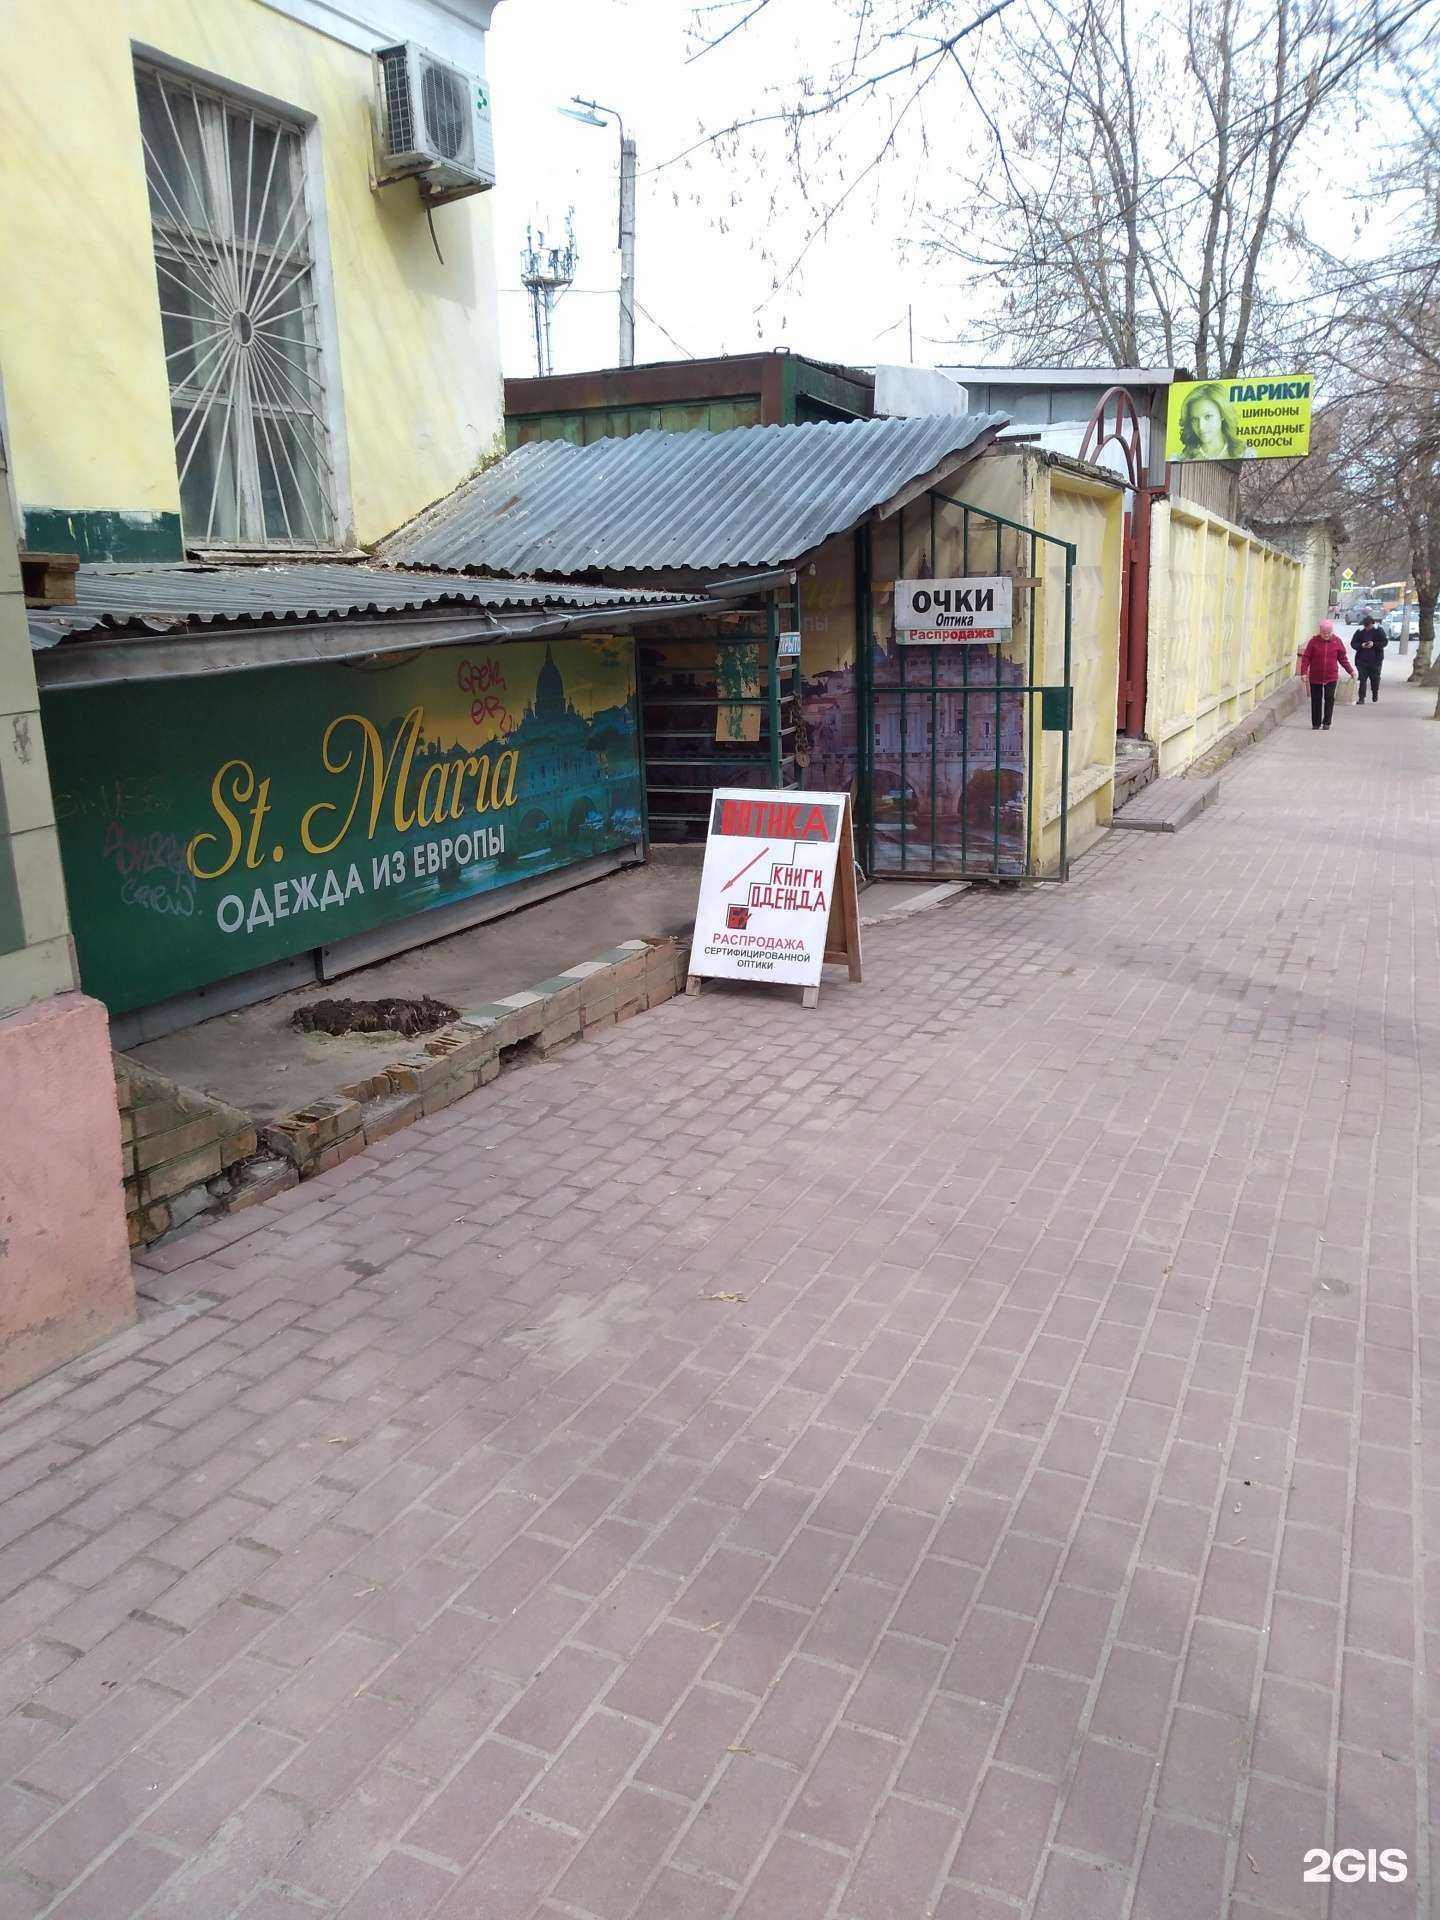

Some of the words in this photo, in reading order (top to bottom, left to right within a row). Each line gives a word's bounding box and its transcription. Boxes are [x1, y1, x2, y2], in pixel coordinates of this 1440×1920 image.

[1229, 382, 1310, 402] ПАРИКИ
[1242, 407, 1299, 418] ШИНЬОНЫ
[1236, 424, 1305, 436] НАКЛАДНЫЕ
[1246, 437, 1293, 447] ВОЛОСЫ
[912, 588, 994, 613] ОЧКИ
[935, 613, 974, 627] Оптика
[909, 629, 995, 642] Распродажа
[186, 759, 284, 880] St.
[301, 705, 520, 855] Maria
[719, 799, 829, 841] ОПТИКА
[216, 863, 365, 933] ОДЕЖДА
[372, 853, 406, 890] ИЗ
[413, 824, 505, 879] ЕВРОПЫ
[772, 866, 823, 889] КНИГИ
[751, 886, 826, 912] ОДЕЖДА
[712, 933, 805, 951] РАСПРОДАЖА
[704, 946, 811, 963] СЕРТИФИЦИРОВАННОЙ
[737, 959, 774, 970] ОПТИКИ
